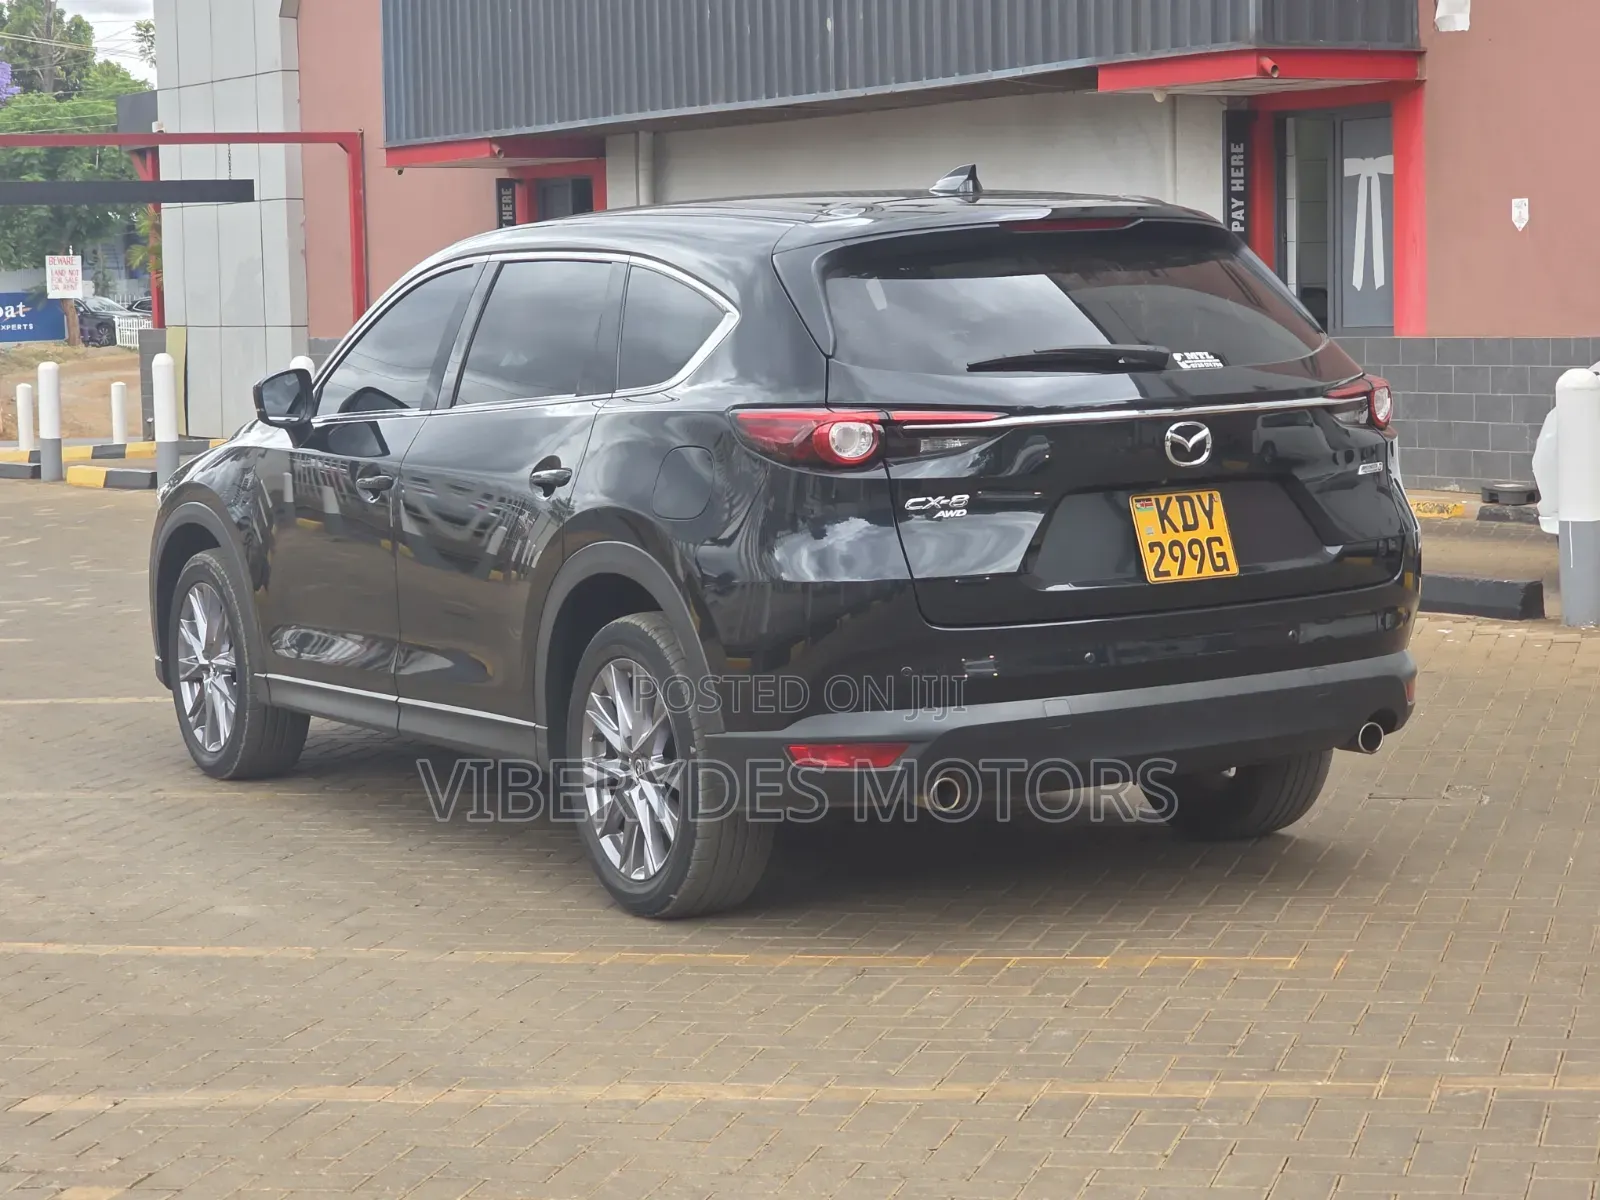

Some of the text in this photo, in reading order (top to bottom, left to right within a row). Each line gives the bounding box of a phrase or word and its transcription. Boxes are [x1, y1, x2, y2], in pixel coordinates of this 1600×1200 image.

[1230, 142, 1245, 232] PAY HERE
[501, 187, 513, 220] HERE
[48, 256, 75, 266] BEWARE
[51, 269, 79, 277] LAND NOT
[51, 276, 63, 284] FOR
[63, 283, 78, 291] RENT
[904, 494, 970, 511] CX-8
[932, 508, 968, 519] AWD
[1154, 493, 1215, 535] KDY
[1148, 536, 1231, 579] 299G
